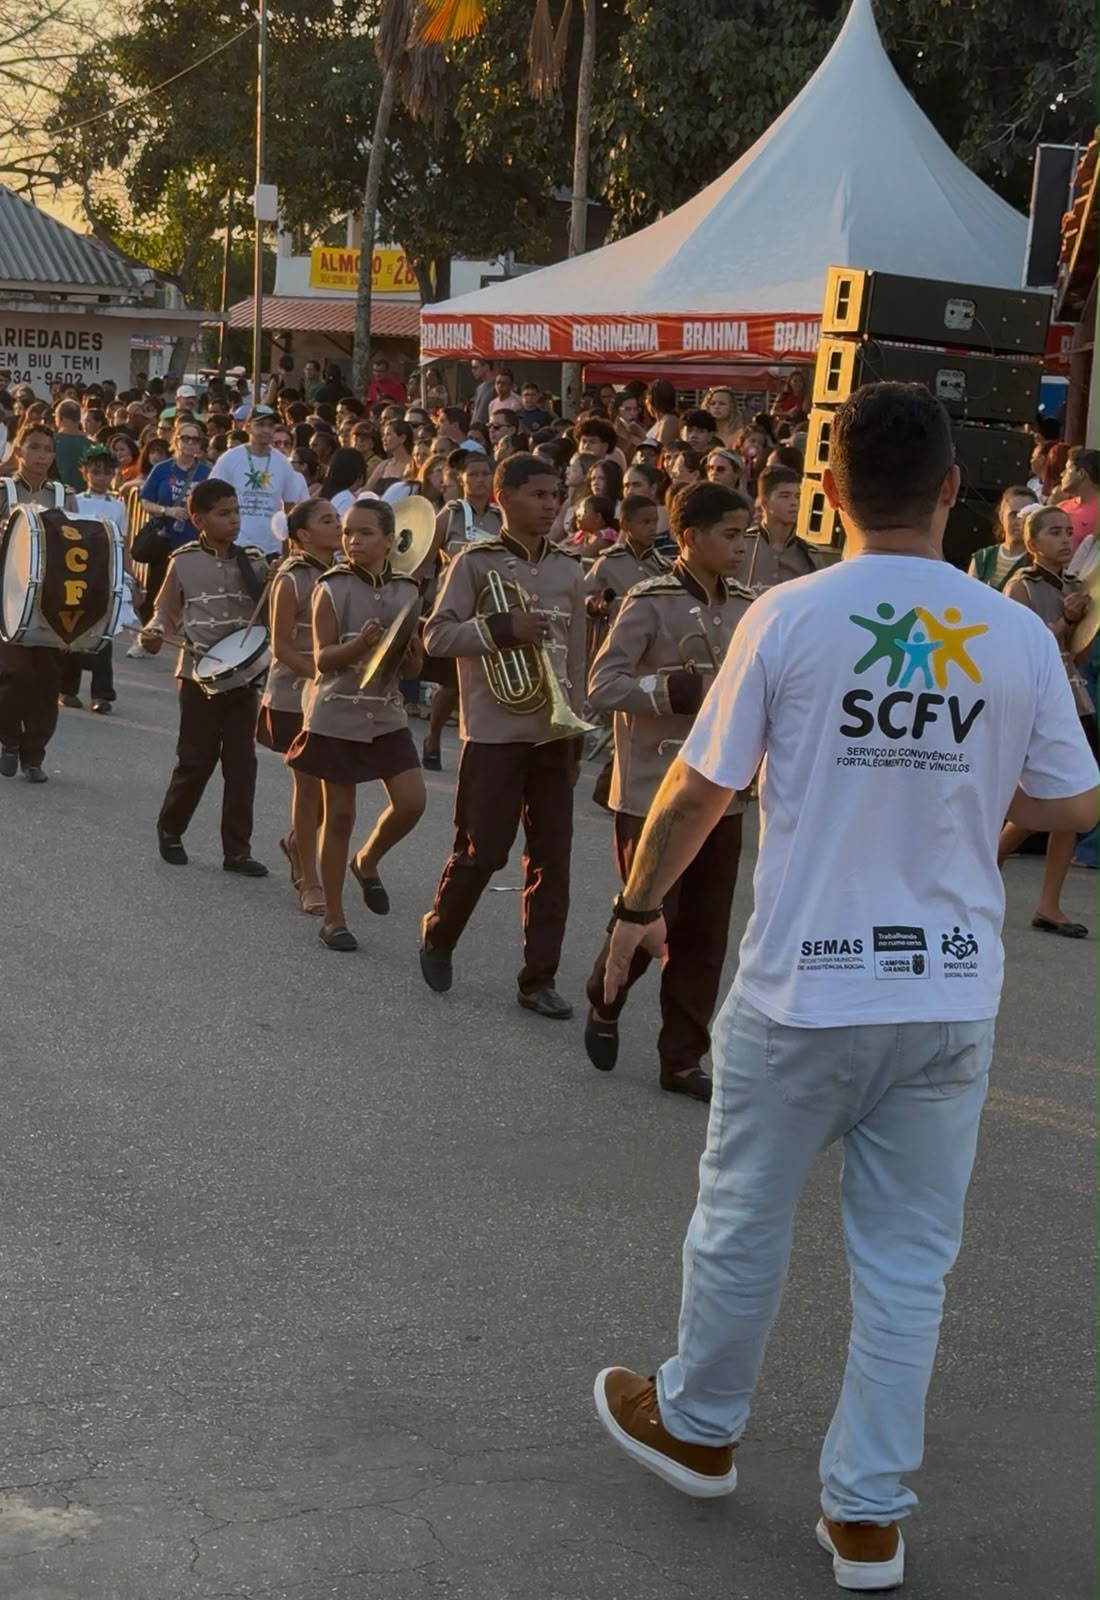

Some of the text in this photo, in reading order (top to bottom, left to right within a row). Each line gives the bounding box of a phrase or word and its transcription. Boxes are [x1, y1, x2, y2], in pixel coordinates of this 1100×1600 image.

[320, 253, 382, 275] ALMOO
[420, 323, 473, 349] BRAHMA
[493, 323, 551, 351] BRAHMA
[683, 322, 748, 351] BRAHMA
[774, 322, 820, 352] BRAH
[28, 353, 52, 368] BIU
[61, 355, 99, 375] TEM!
[840, 689, 985, 744] SCFV
[846, 746, 887, 759] SERVIÇO
[898, 747, 957, 762] CONVIVÊNCIA
[958, 753, 965, 762] E
[913, 760, 927, 770] DE
[929, 760, 970, 773] VÍNCULOS
[801, 938, 864, 956] SEMAS
[944, 961, 978, 970] PROTEÇÃO
